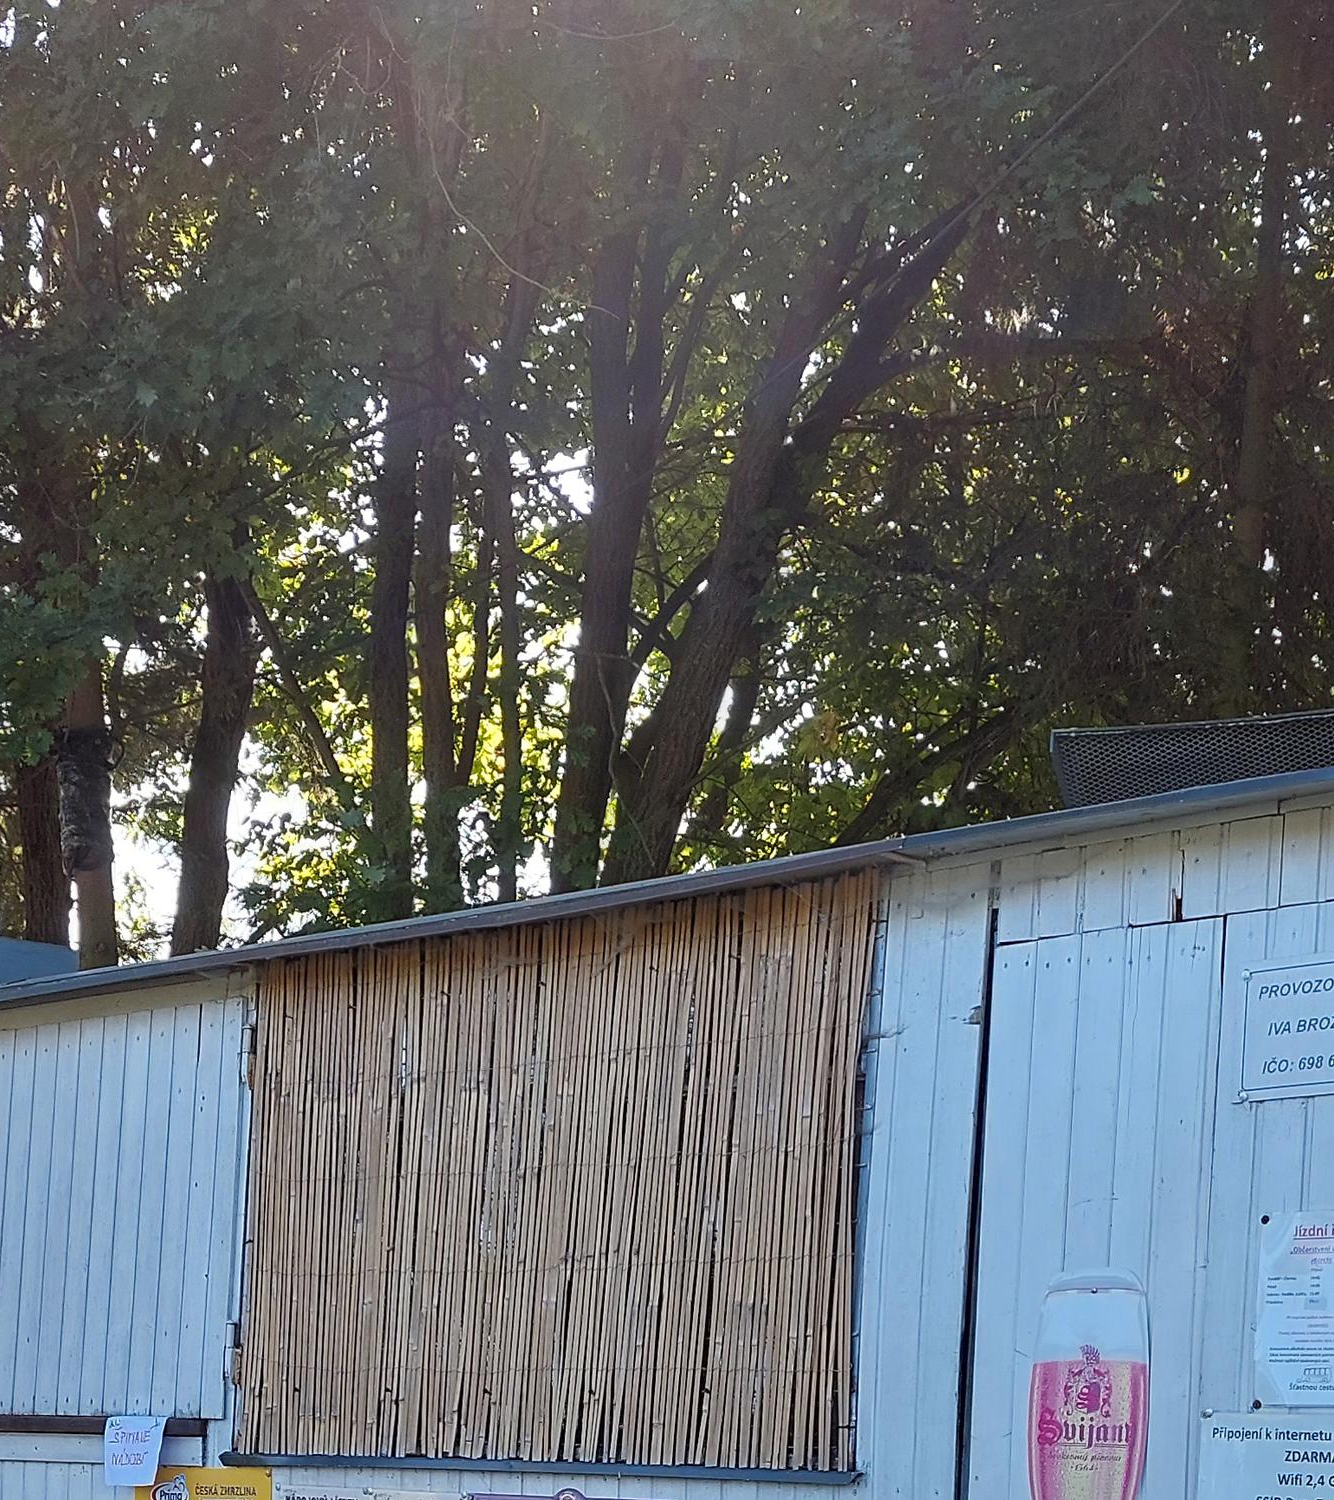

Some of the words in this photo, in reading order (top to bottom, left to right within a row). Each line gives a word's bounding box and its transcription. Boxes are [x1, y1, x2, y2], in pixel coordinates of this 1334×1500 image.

[1267, 1020, 1292, 1036] IVA
[1261, 1056, 1294, 1075] IČO:
[1298, 1056, 1324, 1071] 698
[1293, 1223, 1329, 1238] Jízdní
[1212, 1426, 1264, 1442] Připojení
[1265, 1428, 1272, 1440] k
[1274, 1428, 1332, 1441] internetu
[195, 1482, 218, 1496] ČESKÁ
[220, 1486, 257, 1497] ZMRZLINA
[1277, 1473, 1303, 1486] Wifi
[1305, 1474, 1325, 1490] 2,4
